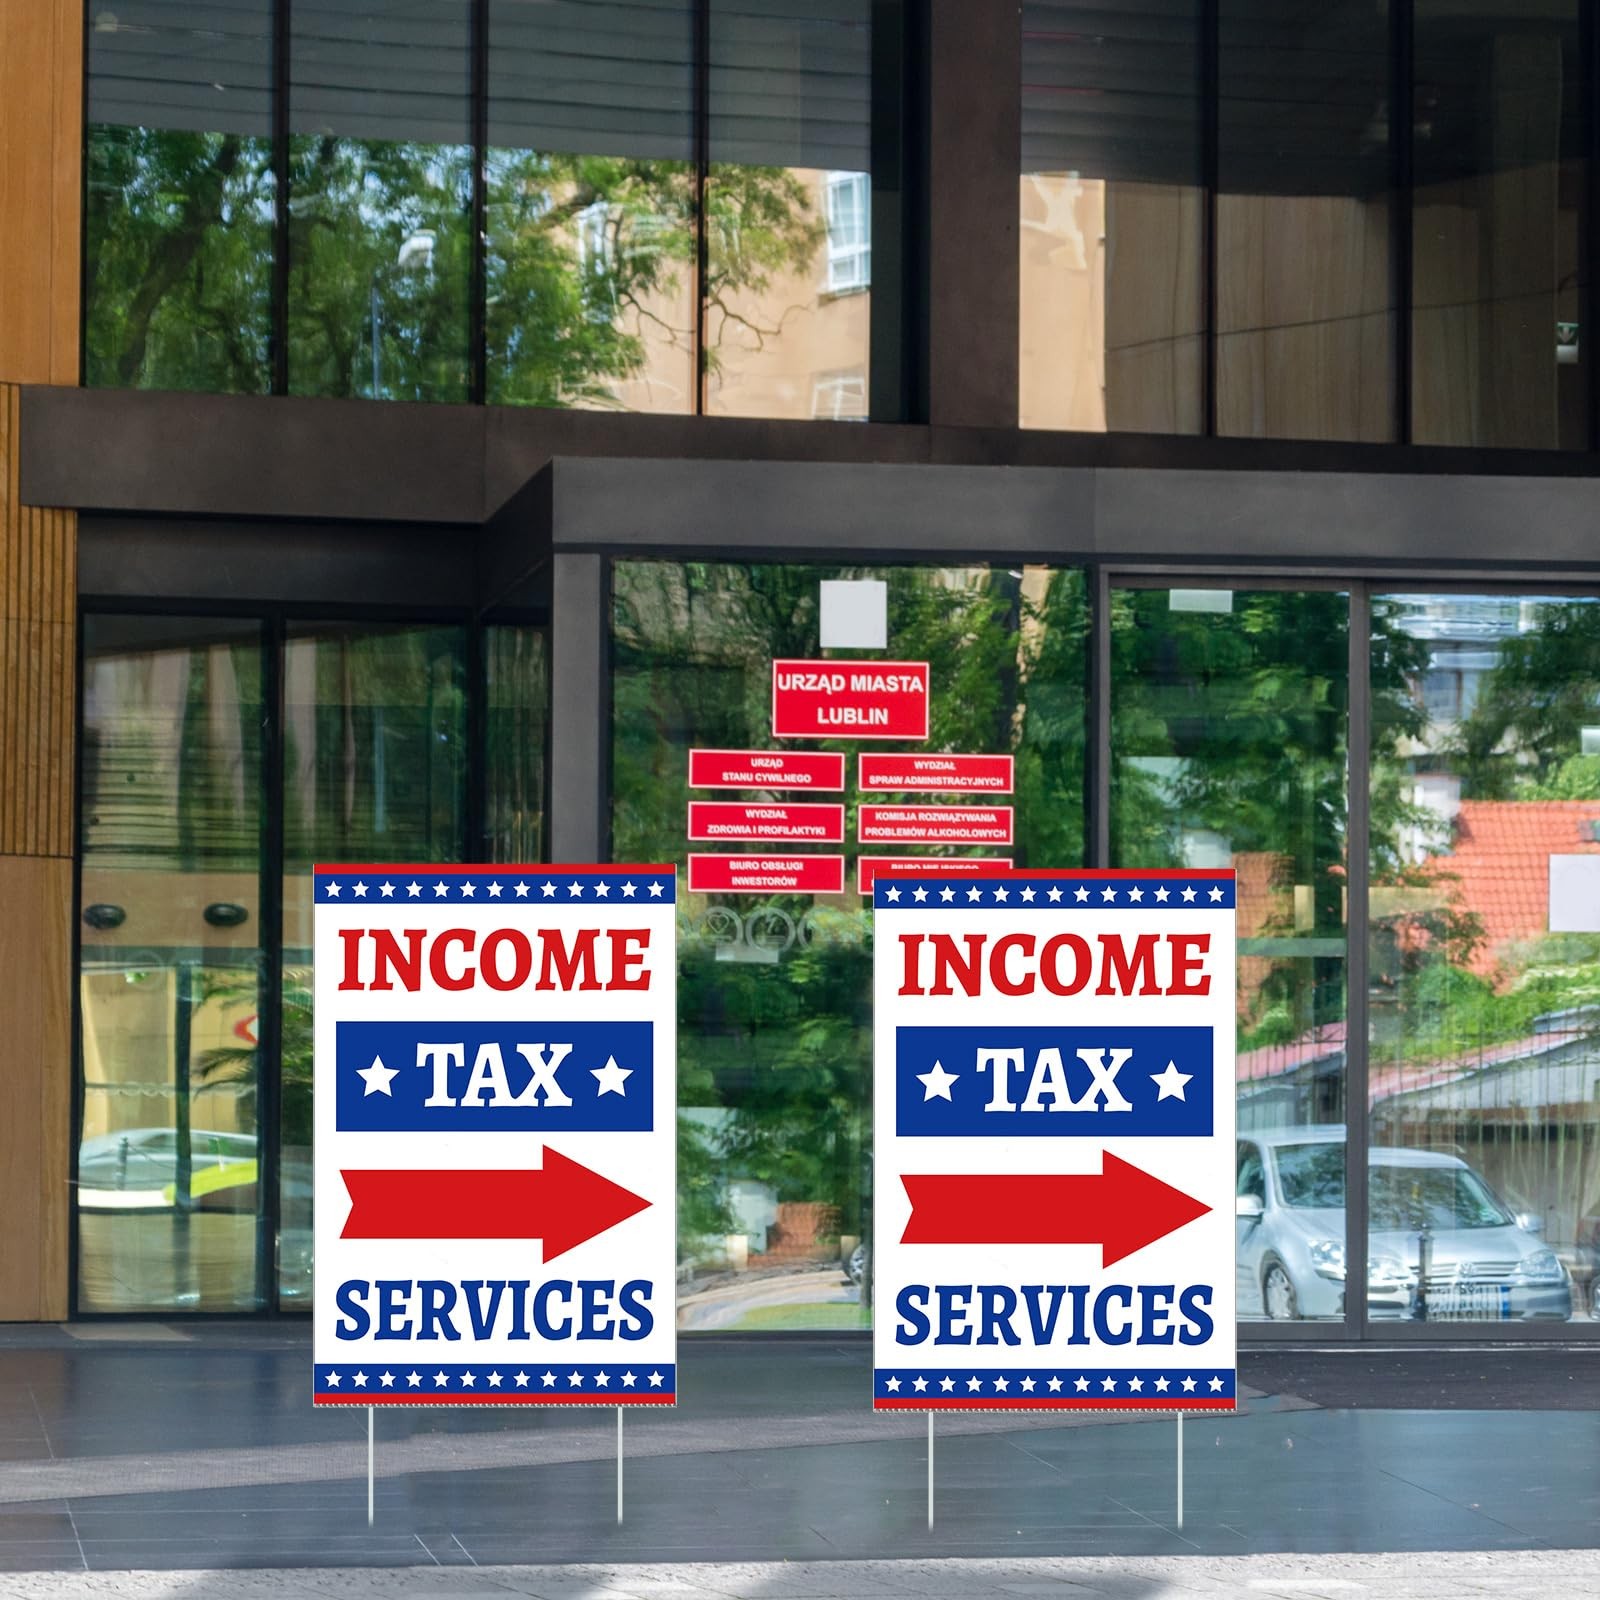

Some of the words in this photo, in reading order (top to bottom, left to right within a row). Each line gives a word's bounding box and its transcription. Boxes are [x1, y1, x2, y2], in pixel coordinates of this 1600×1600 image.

[777, 674, 845, 695] URZĄD
[850, 674, 924, 693] MIASTA
[817, 707, 888, 725] LUBLIN
[751, 758, 784, 769] URZĄD
[914, 760, 956, 770] WYDZIAŁ
[722, 772, 753, 782] STANU
[755, 773, 812, 783] CYWILNEGO
[869, 775, 903, 785] SPRAW
[904, 776, 1004, 786] ADMINISTRACYJNYCH
[745, 809, 788, 819] WYDZIAŁ
[875, 812, 917, 822] KOMISJA
[918, 812, 997, 824] ROZWIĄZYWANIA
[707, 824, 751, 835] ZDROWIA
[753, 825, 757, 834] I
[758, 825, 826, 836] PROFILAKTYKI
[865, 826, 926, 837] PROBLEMÓW
[927, 827, 1006, 838] ALKOHOLOWYCH
[729, 860, 760, 870] BIURO
[761, 861, 804, 871] OBSŁUGI
[731, 875, 797, 886] INWESTORÓW
[339, 929, 651, 991] INCOME
[899, 934, 1211, 996] INCOME
[417, 1043, 572, 1106] TAX
[977, 1048, 1132, 1111] TAX
[336, 1280, 653, 1341] SERVICES
[896, 1285, 1213, 1346] SERVICES
